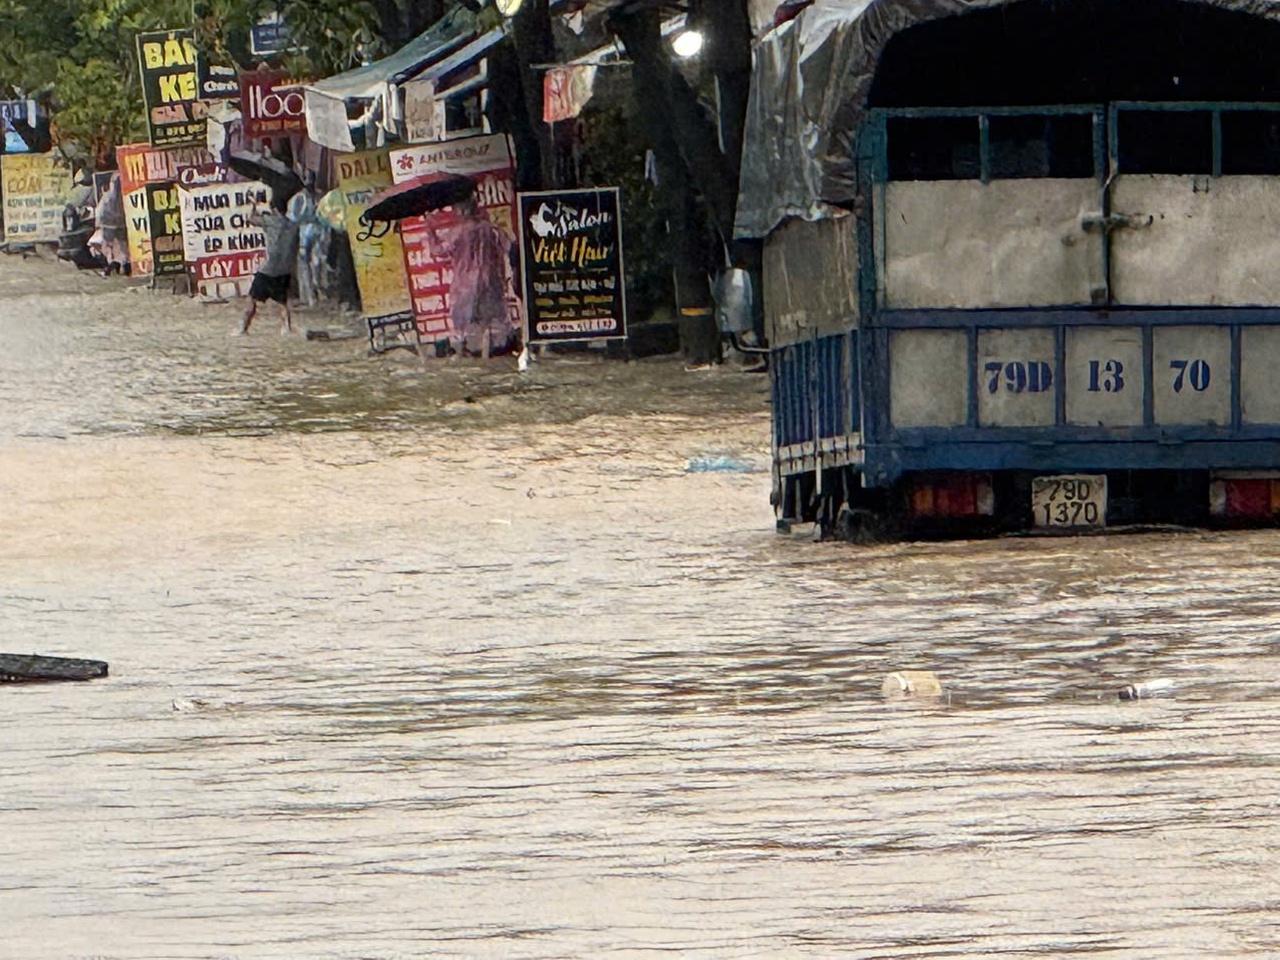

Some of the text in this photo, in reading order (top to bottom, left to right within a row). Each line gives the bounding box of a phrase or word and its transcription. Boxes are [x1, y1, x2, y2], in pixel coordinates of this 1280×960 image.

[984, 359, 1210, 394] 79D 13 70
[1048, 478, 1091, 501] 79D
[1043, 501, 1098, 525] 1370
